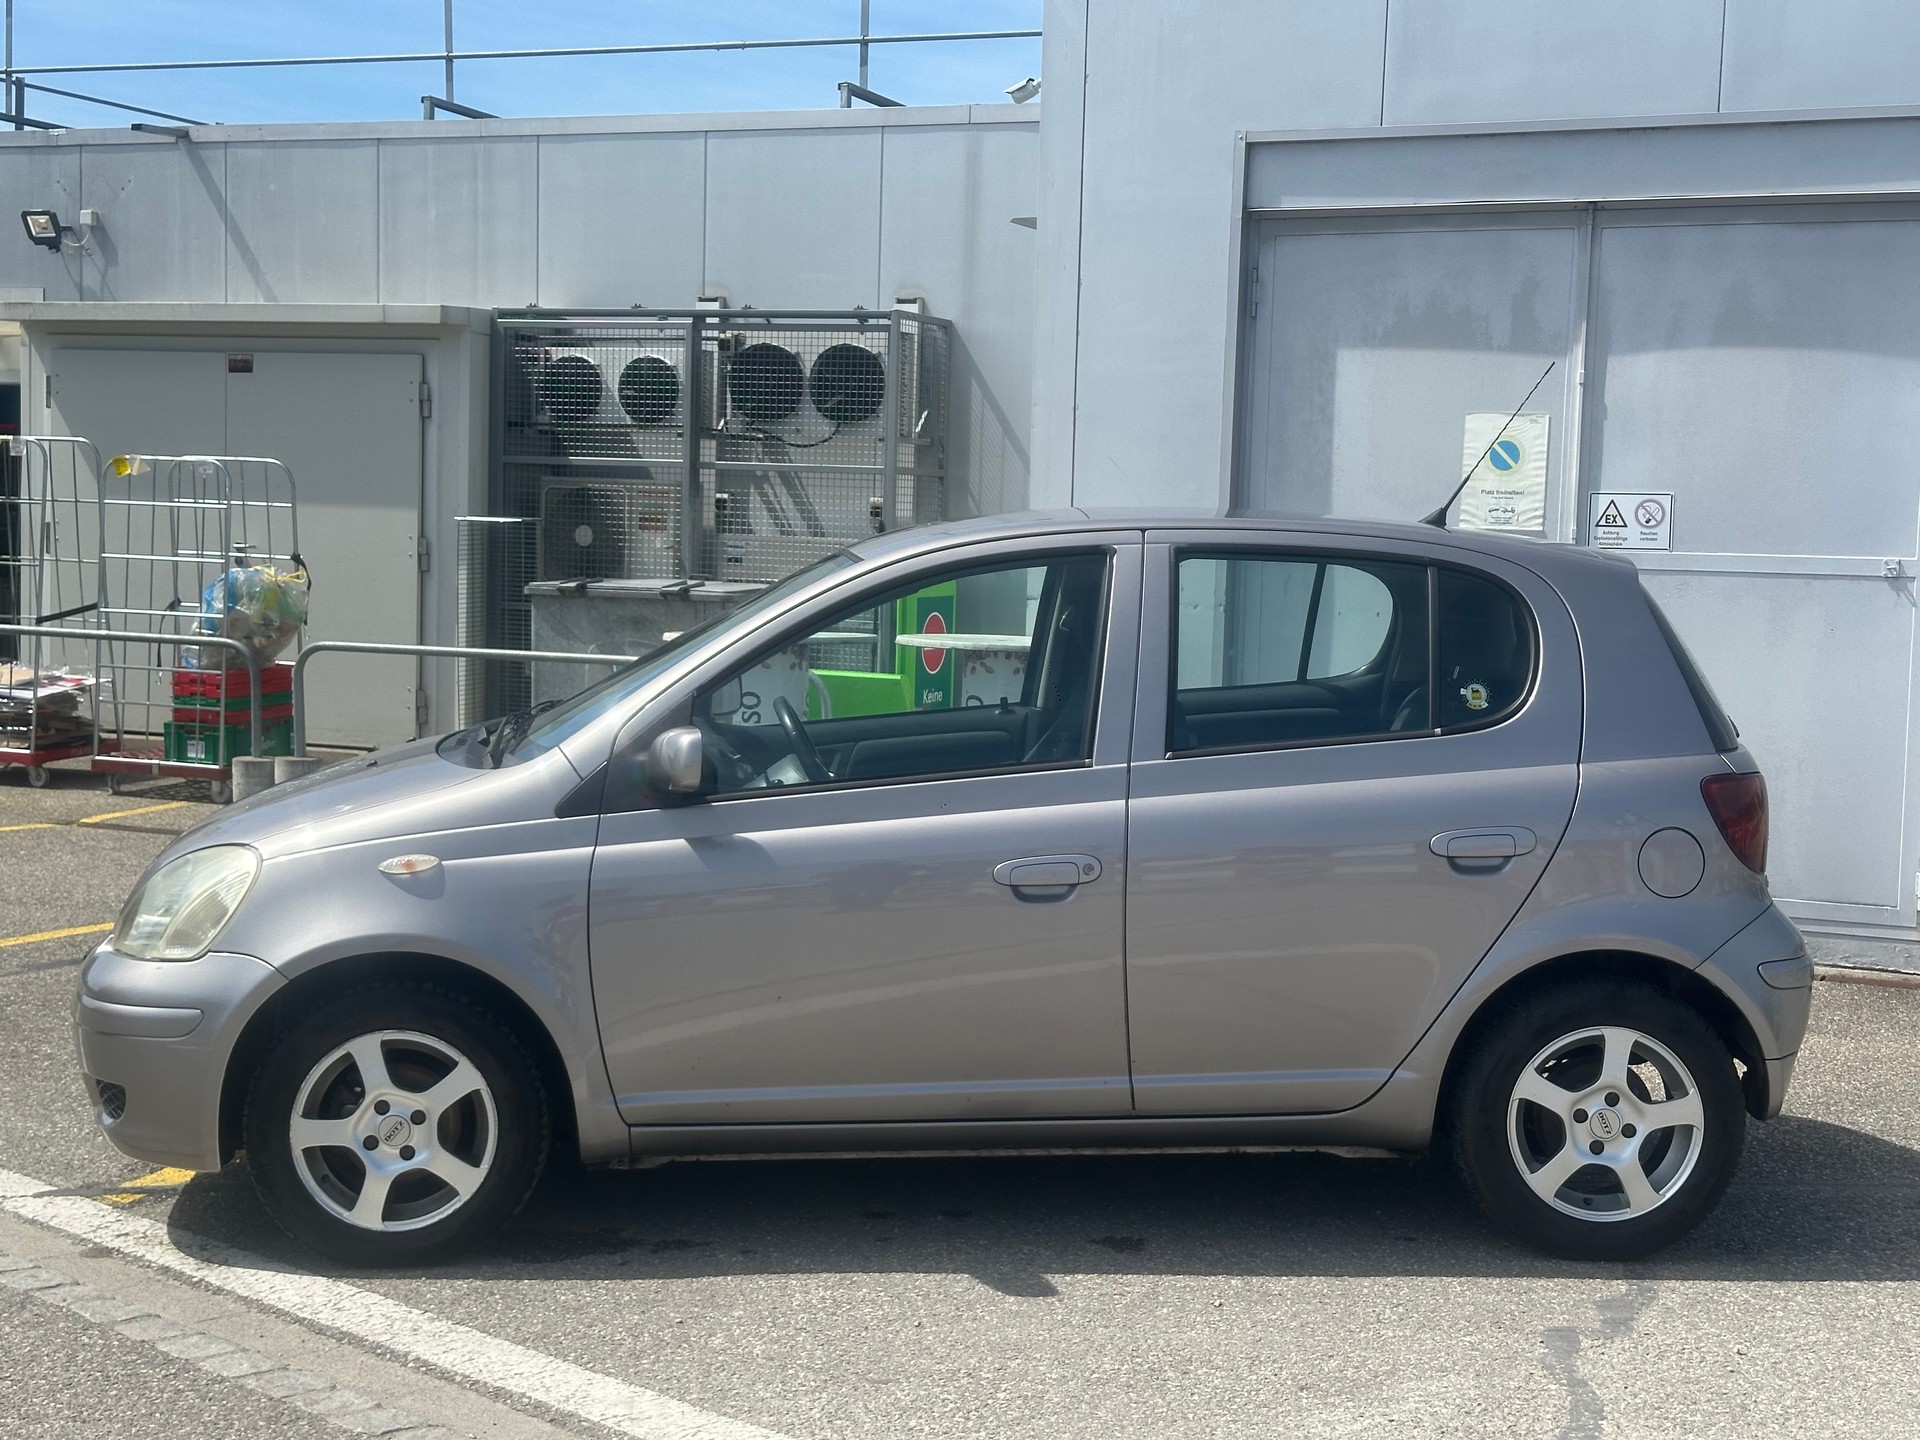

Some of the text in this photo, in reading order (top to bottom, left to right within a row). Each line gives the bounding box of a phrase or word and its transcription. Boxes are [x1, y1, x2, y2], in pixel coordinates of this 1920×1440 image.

[1605, 514, 1618, 524] EX
[923, 688, 943, 704] Keine
[384, 1120, 406, 1142] DOTZ
[1597, 1111, 1612, 1136] DOTZ
